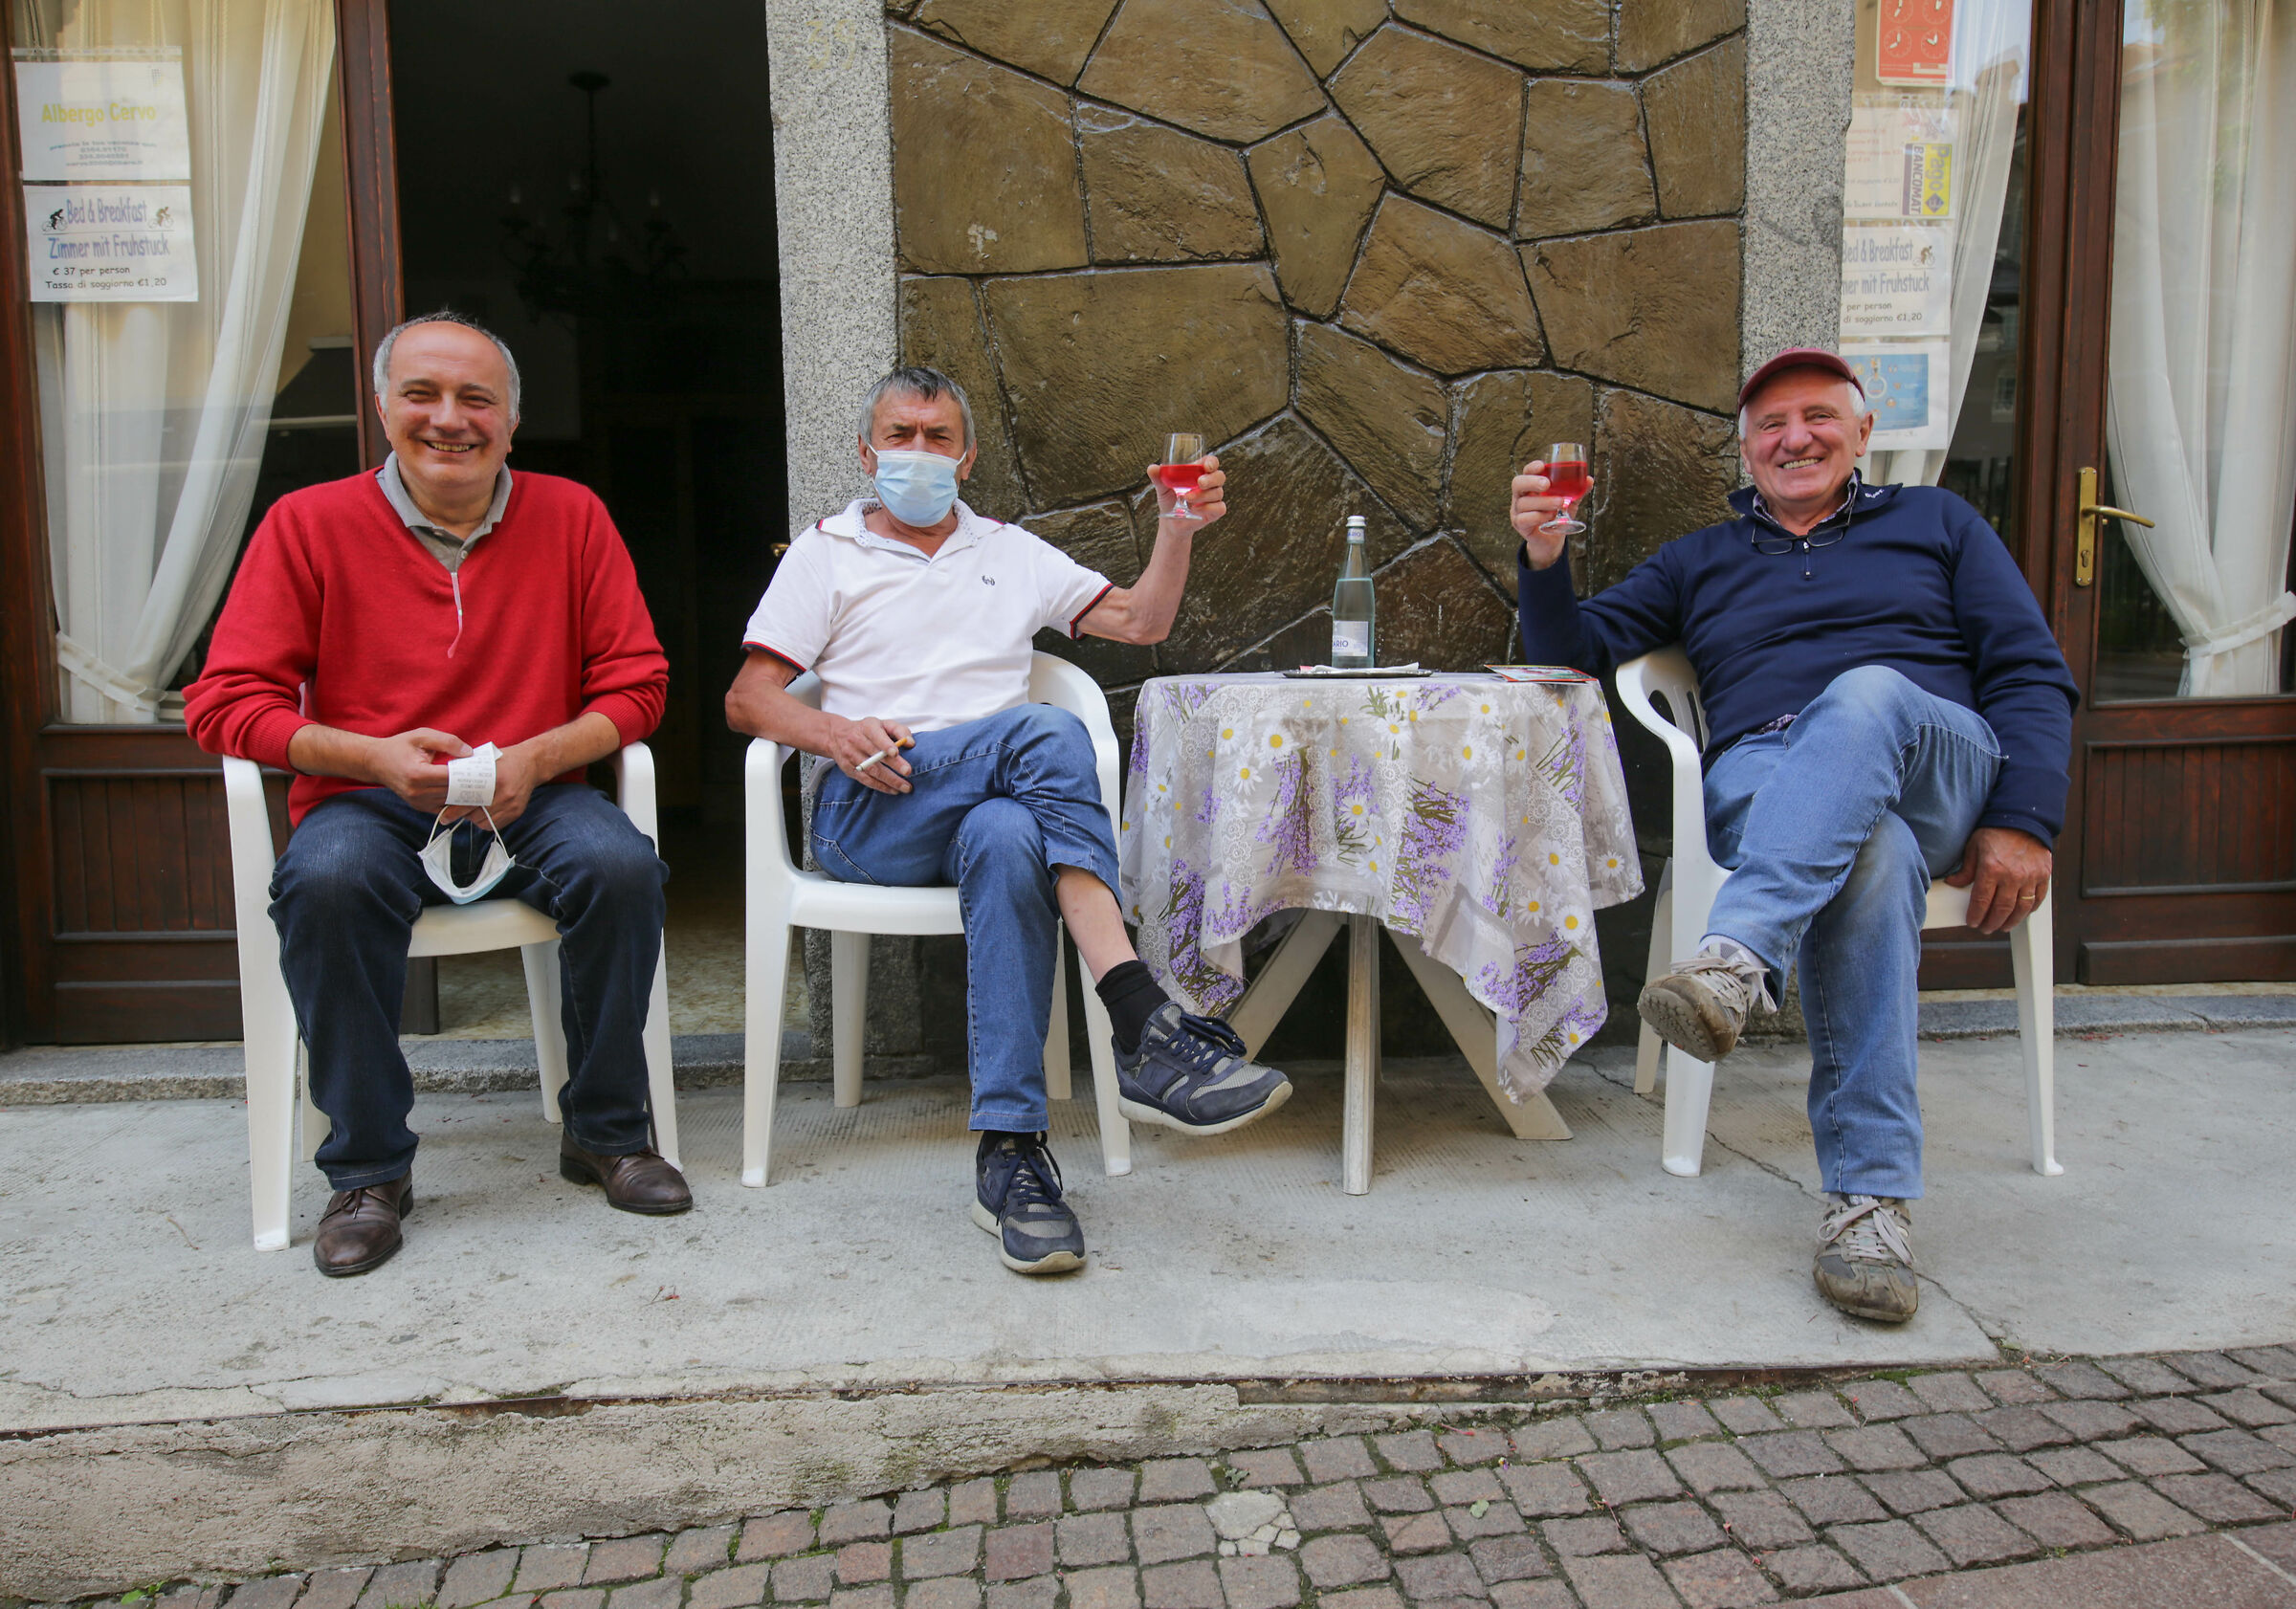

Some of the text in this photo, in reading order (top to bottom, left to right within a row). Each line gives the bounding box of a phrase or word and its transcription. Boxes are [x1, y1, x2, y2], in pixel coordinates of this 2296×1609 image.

[41, 101, 157, 127] Albergo Cervo
[1910, 145, 1925, 214] BANCOMAT
[1925, 145, 1951, 191] Pago
[66, 196, 147, 225] Bed & Breakfast
[48, 236, 90, 260] Zimmer
[93, 235, 111, 258] mit
[1869, 236, 1914, 264] Breakfast
[53, 266, 131, 277] € 37 per person
[45, 280, 74, 289] Tassa
[77, 279, 86, 288] di
[90, 278, 135, 291] soggiorno
[1862, 274, 1878, 295] mit
[1843, 315, 1851, 323] di
[1854, 313, 1894, 325] soggiorno
[1846, 301, 1893, 313] per person
